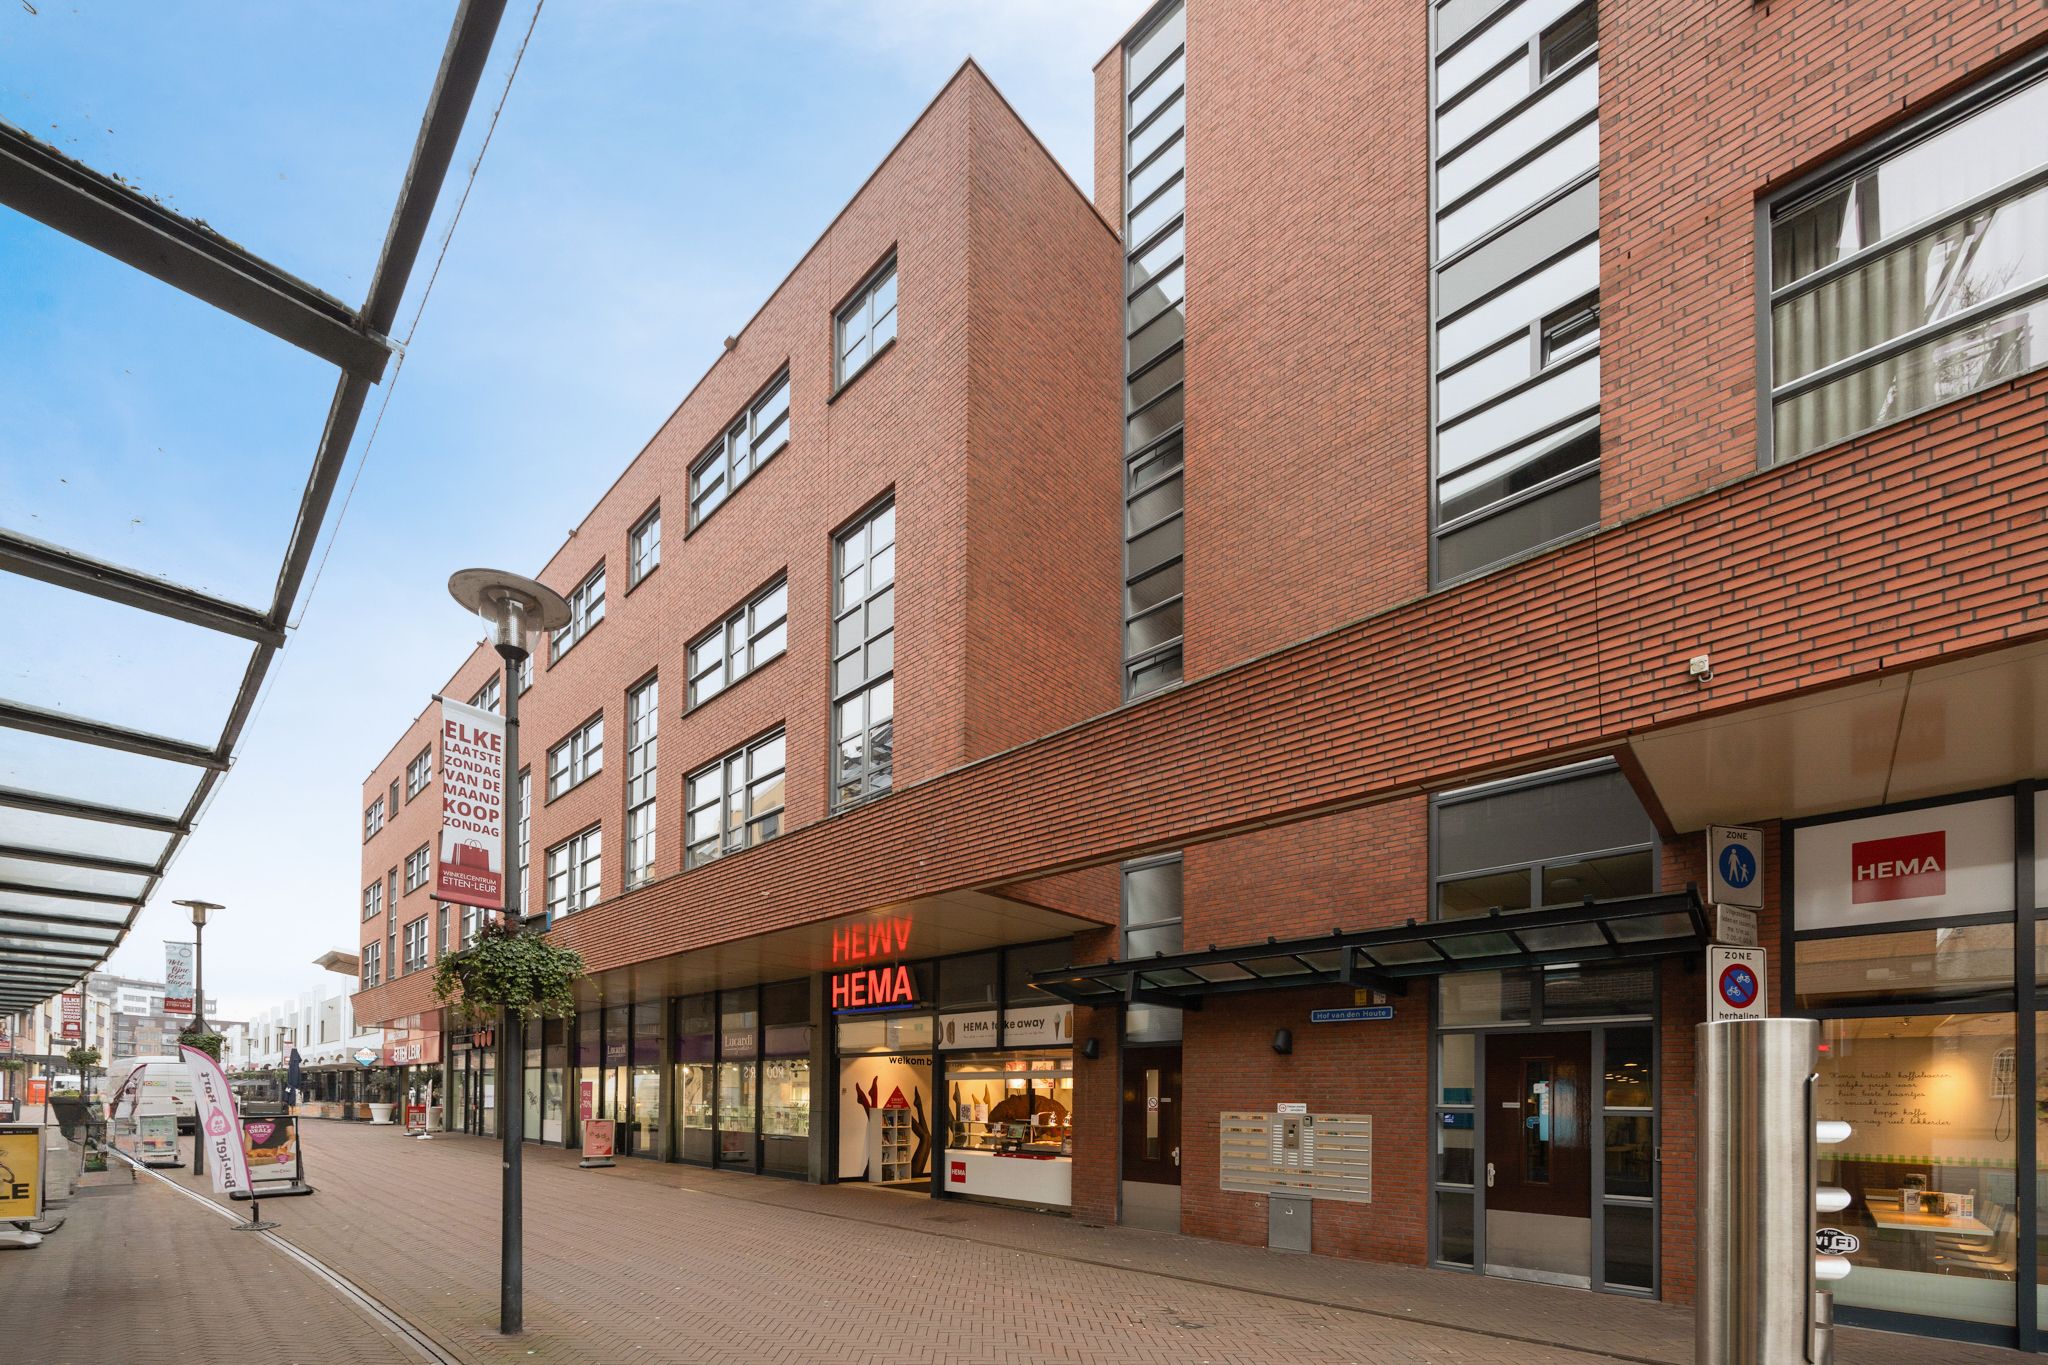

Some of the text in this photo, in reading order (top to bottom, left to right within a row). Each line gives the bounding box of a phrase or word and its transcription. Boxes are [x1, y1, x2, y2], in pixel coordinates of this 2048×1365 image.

[445, 719, 501, 752] ELKE
[445, 740, 501, 766] LAATSTE
[445, 755, 501, 779] ZONDAG
[445, 768, 500, 793] VAN DE
[443, 783, 500, 806] MAAND
[443, 798, 499, 822] KOOP
[443, 816, 499, 837] ZONDAG
[1726, 830, 1748, 841] ZONE
[443, 870, 497, 886] WINKELCENTRUM
[1857, 855, 1941, 881] HEMA
[443, 877, 497, 894] ETTEN-LEUR
[1724, 951, 1752, 960] ZONE
[832, 965, 913, 1008] HEMA
[963, 1018, 1045, 1032] HEMA tke away
[725, 1034, 753, 1047] Lucardi
[889, 1056, 925, 1066] welkom
[951, 1168, 966, 1176] HEMA
